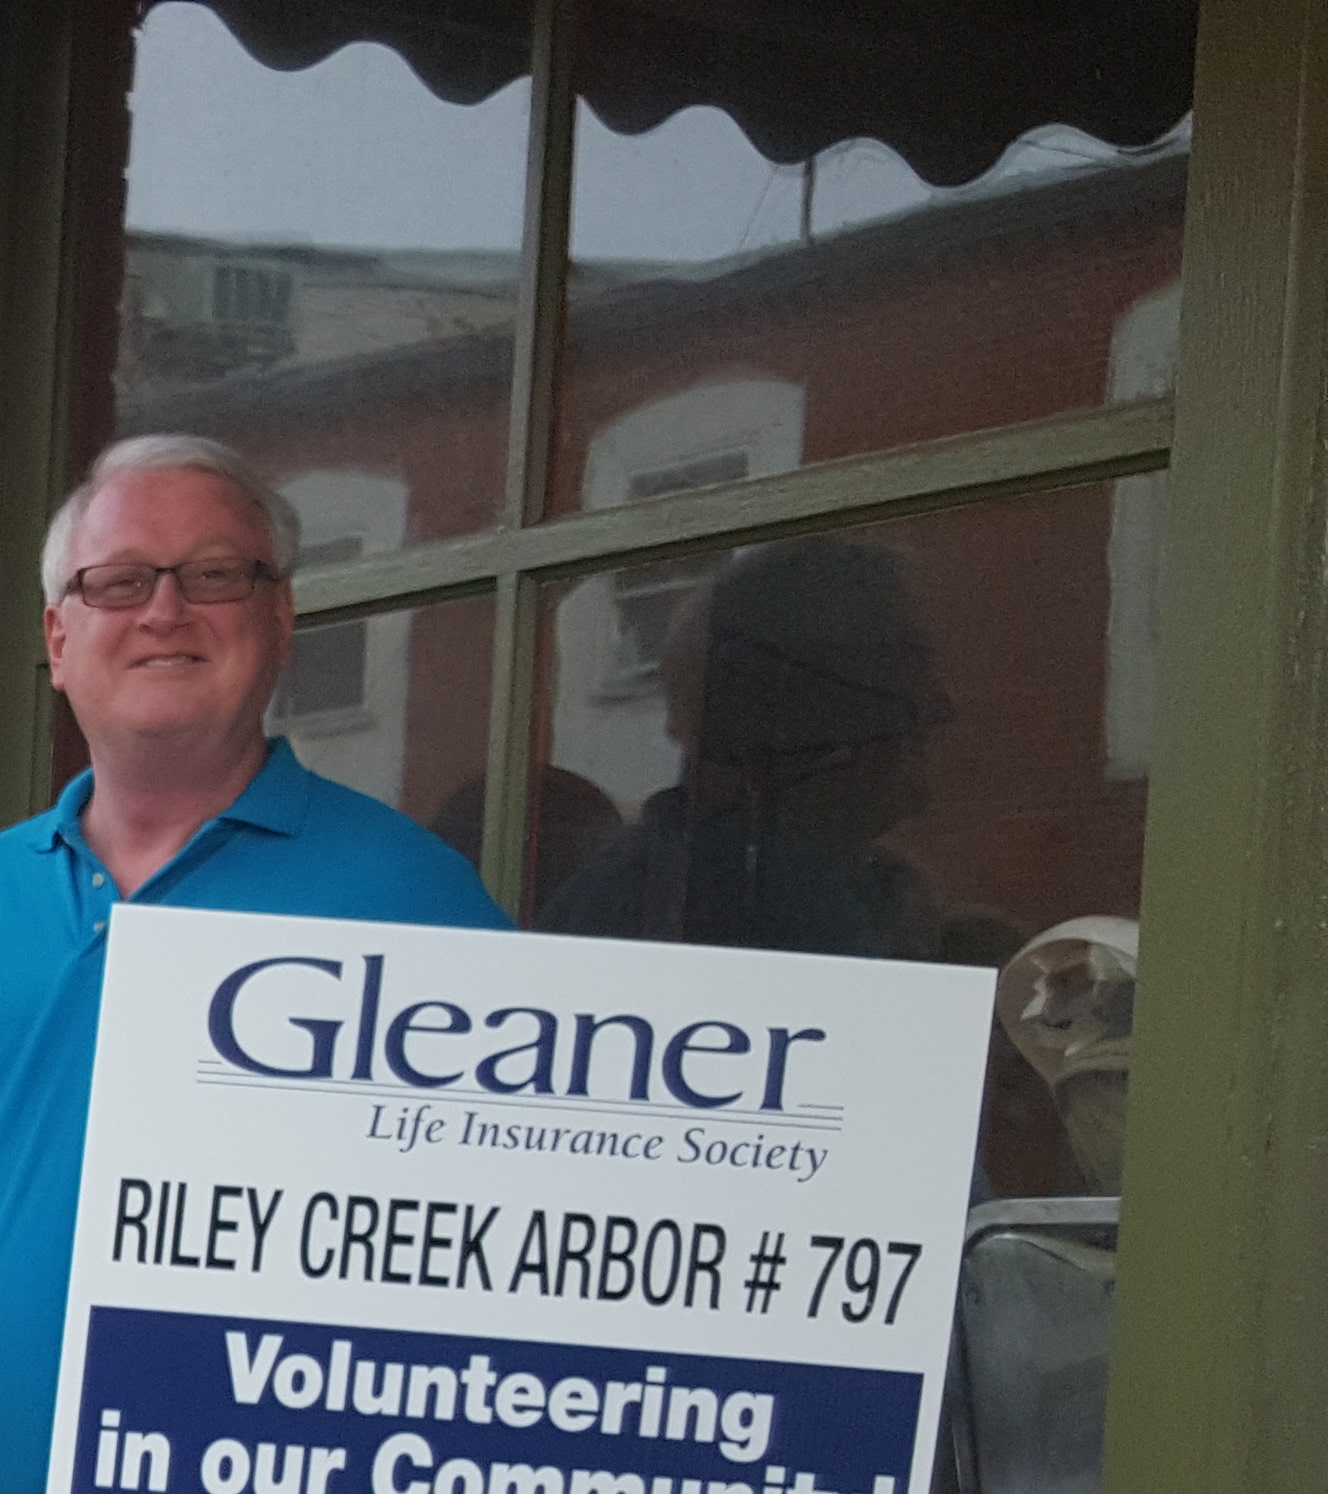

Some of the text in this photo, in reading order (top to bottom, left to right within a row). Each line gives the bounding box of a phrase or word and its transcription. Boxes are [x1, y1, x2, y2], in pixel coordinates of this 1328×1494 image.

[206, 953, 827, 1111] Gleaner
[364, 1103, 829, 1182] Life Insurance Society
[111, 1177, 923, 1325] RILEY CREEK ARBOR # 797
[94, 1410, 171, 1493] in
[224, 1331, 776, 1463] Volunteering
